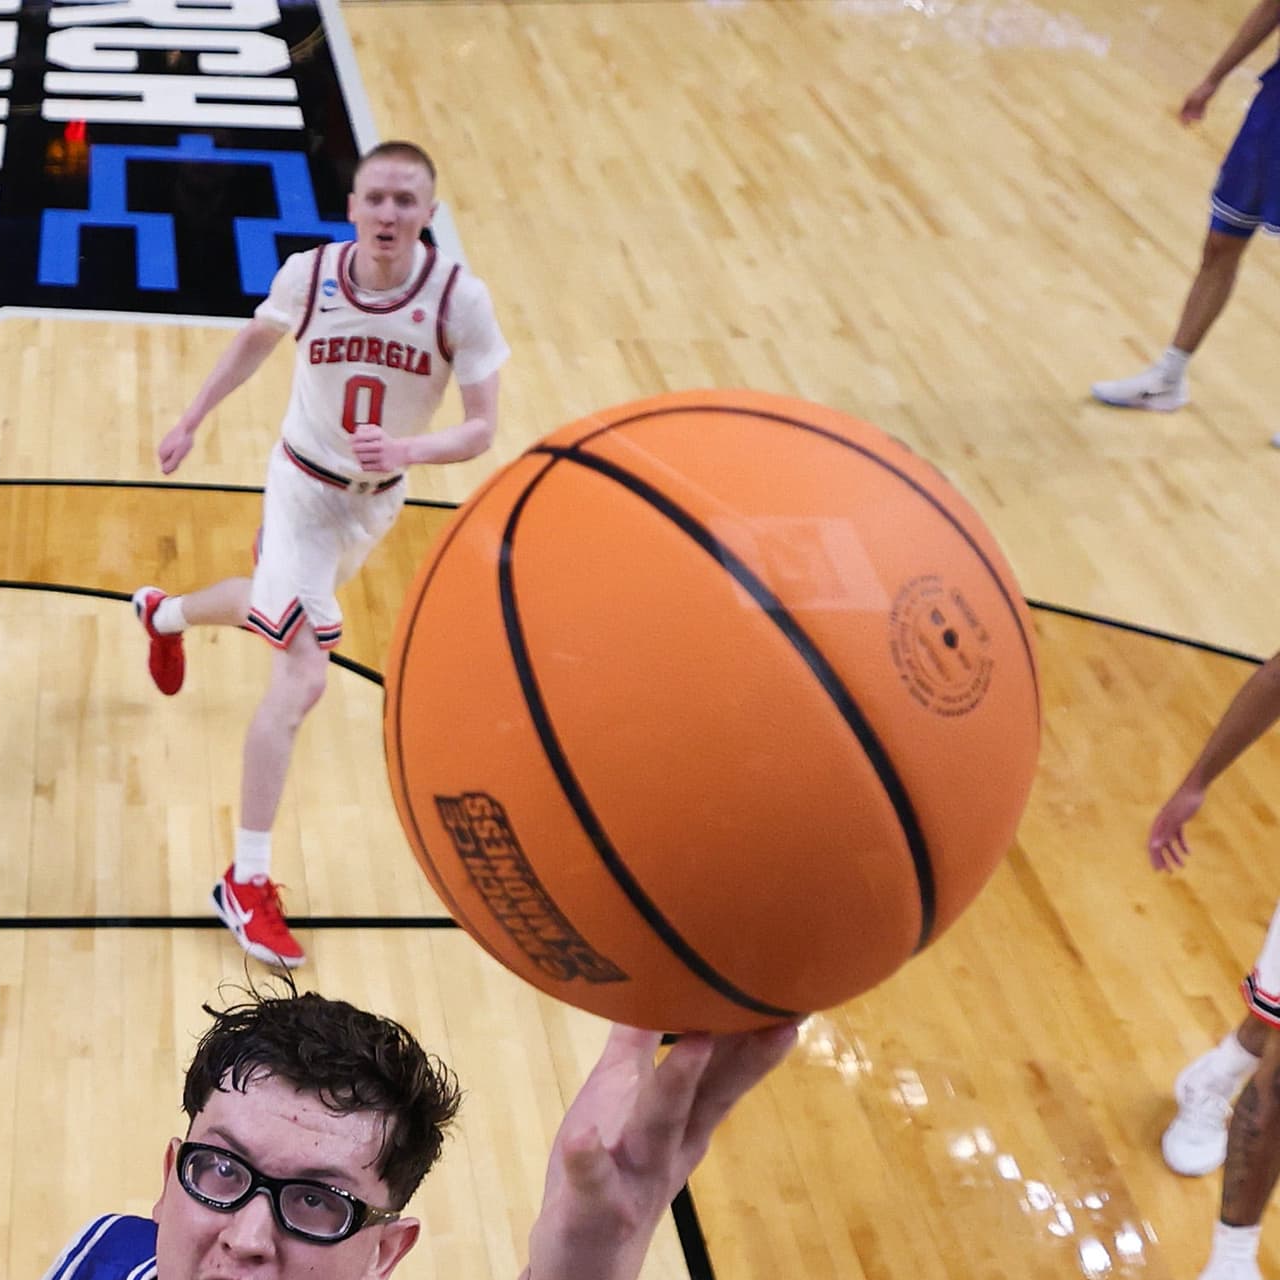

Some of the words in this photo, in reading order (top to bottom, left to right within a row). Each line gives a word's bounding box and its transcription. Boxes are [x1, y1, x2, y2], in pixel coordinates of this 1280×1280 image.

[41, 0, 305, 130] RCH
[309, 335, 432, 376] GEORGIA
[341, 374, 387, 434] 0
